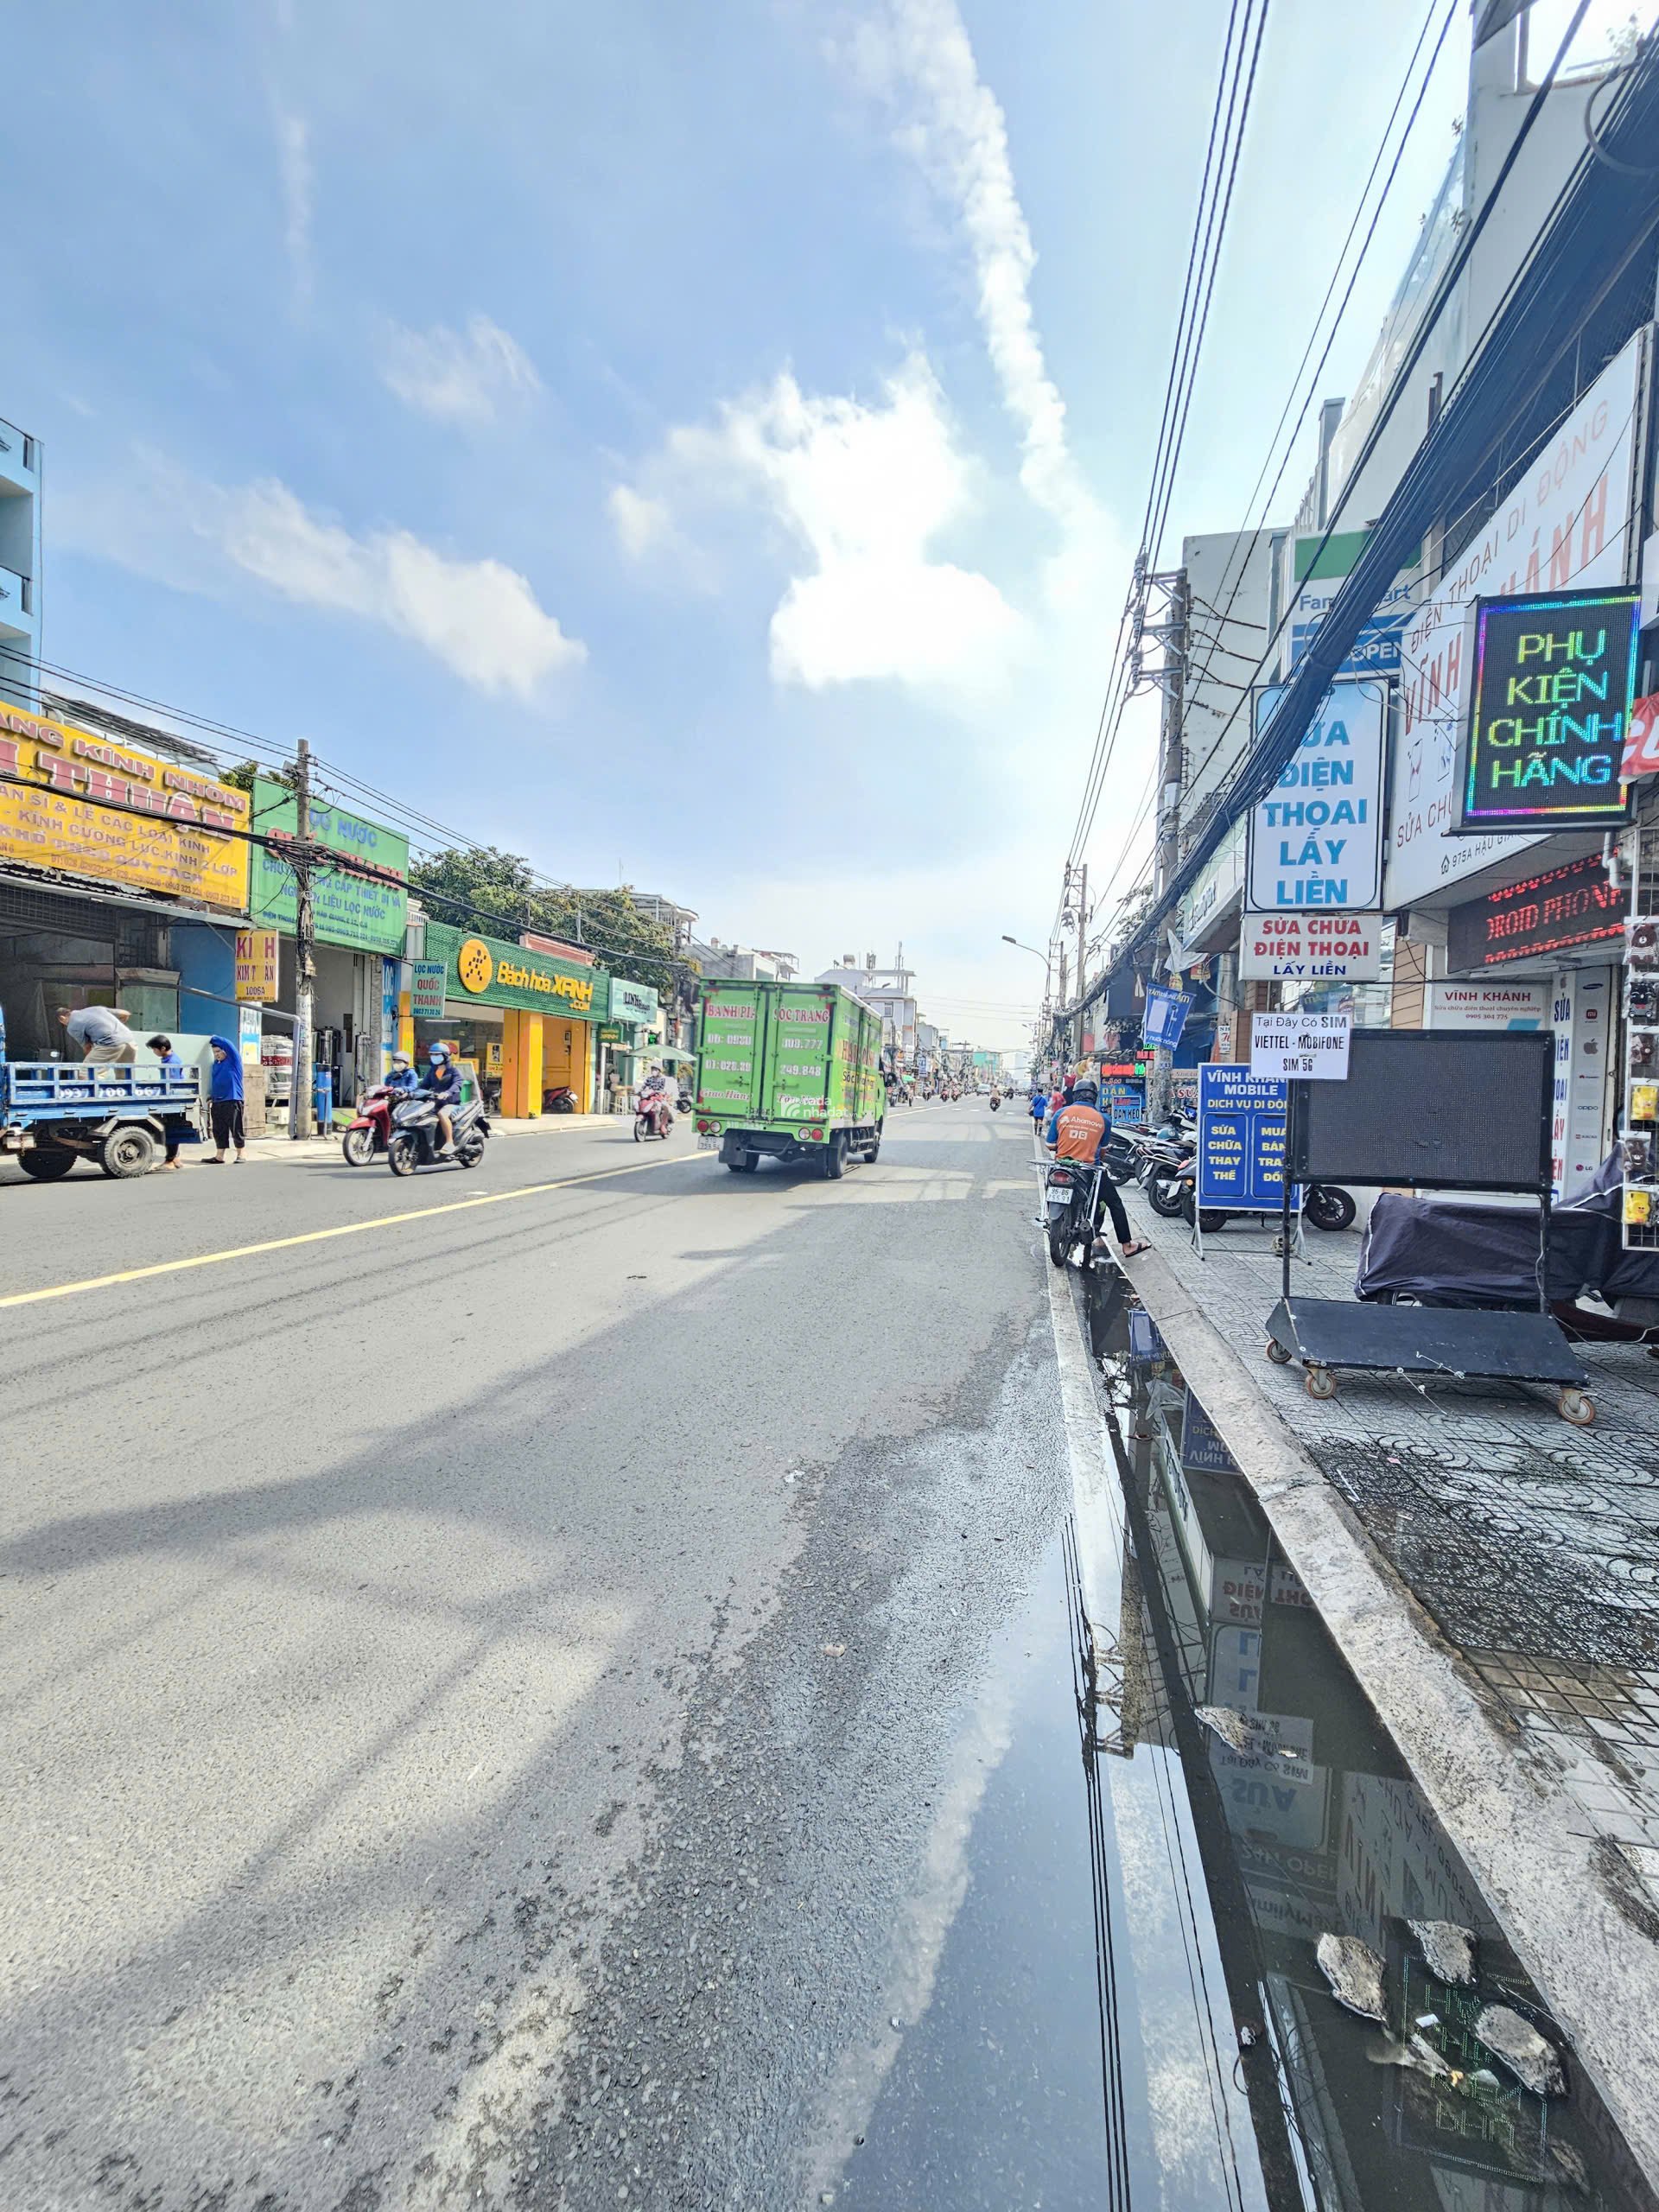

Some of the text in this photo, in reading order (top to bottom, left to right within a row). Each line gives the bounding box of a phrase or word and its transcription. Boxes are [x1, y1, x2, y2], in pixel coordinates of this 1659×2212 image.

[1447, 529, 1499, 604] THOẠI
[1507, 497, 1527, 542] DI
[1537, 399, 1609, 507] ĐỘNG
[1405, 470, 1609, 736] VĨNH ÁNH
[1517, 629, 1606, 665] PHỤ
[1507, 667, 1608, 709] KIỆN
[1488, 709, 1622, 747] CHÍNH
[73, 739, 156, 781] KÍNH
[164, 771, 247, 812] NHÔM
[1491, 752, 1611, 788] HÃNG
[1452, 850, 1472, 868] 975A
[1262, 917, 1362, 935] SỬA CHỮA
[236, 931, 275, 960] KÍH
[1254, 939, 1370, 960] ĐIỆN THOẠI
[251, 961, 274, 984] TẬN
[1273, 960, 1347, 976] LẤY LIỀN
[497, 961, 530, 988] Bách
[550, 973, 594, 1003] XANH
[1445, 990, 1531, 1001] VĨNH KHÁNH
[1255, 1016, 1347, 1030] Tại Đây Có SIM
[1255, 1035, 1290, 1049] VIETTEL
[1298, 1034, 1344, 1050] MOBIFONE
[1555, 1034, 1569, 1067] IỆN
[1283, 1058, 1313, 1071] SIM 5G
[1207, 1070, 1243, 1083] VĨNH
[1224, 1084, 1278, 1096] MOBILE
[1208, 1099, 1234, 1110] DỊCH
[1236, 1100, 1251, 1110] VỤ
[1254, 1100, 1265, 1109] DI
[1071, 1116, 1104, 1128] Ahamove
[1211, 1124, 1236, 1135] SỬA
[1208, 1141, 1243, 1150] CHỮA
[1209, 1156, 1242, 1166] THAY
[1258, 1158, 1287, 1166] TRA
[1213, 1169, 1236, 1180] THẾ
